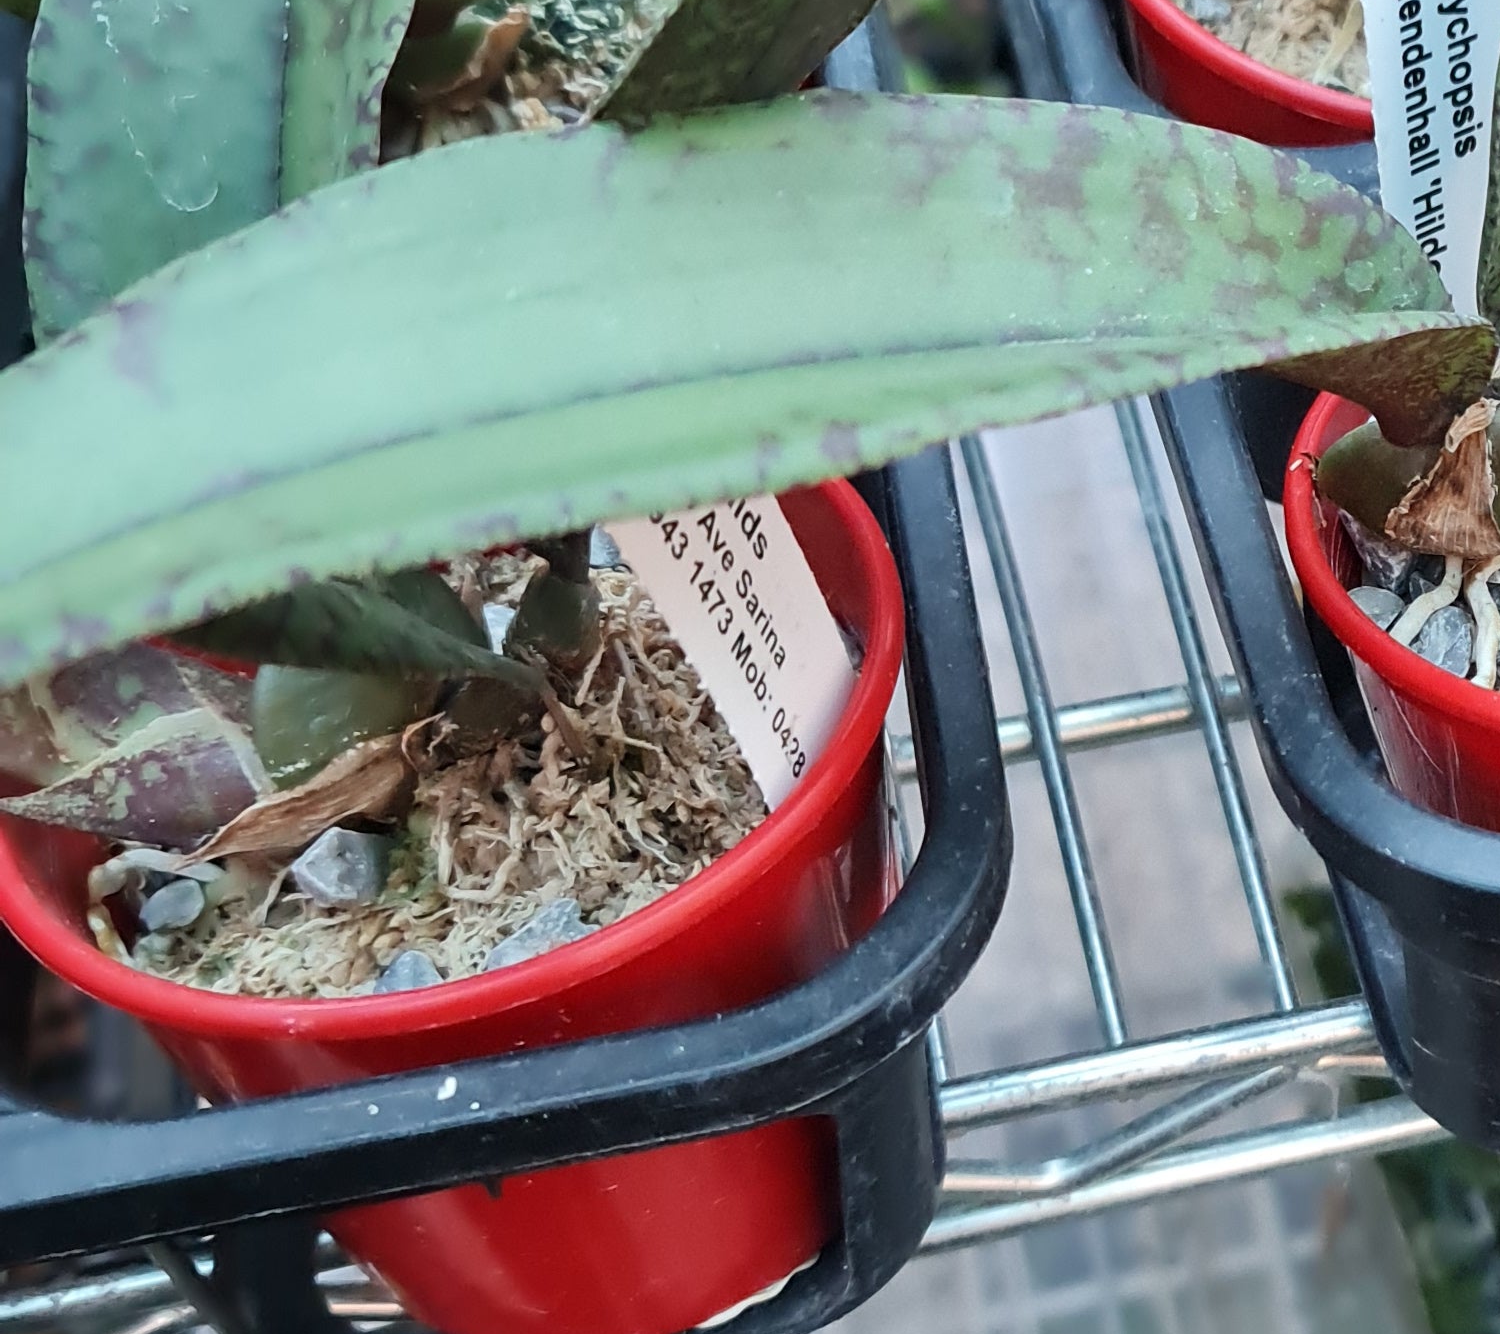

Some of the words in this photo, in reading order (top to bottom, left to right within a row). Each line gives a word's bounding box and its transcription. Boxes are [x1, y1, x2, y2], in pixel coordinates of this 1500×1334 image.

[689, 560, 736, 636] 1473
[731, 631, 776, 712] Mob:
[696, 509, 735, 573] Ave
[735, 569, 788, 671] Sarina
